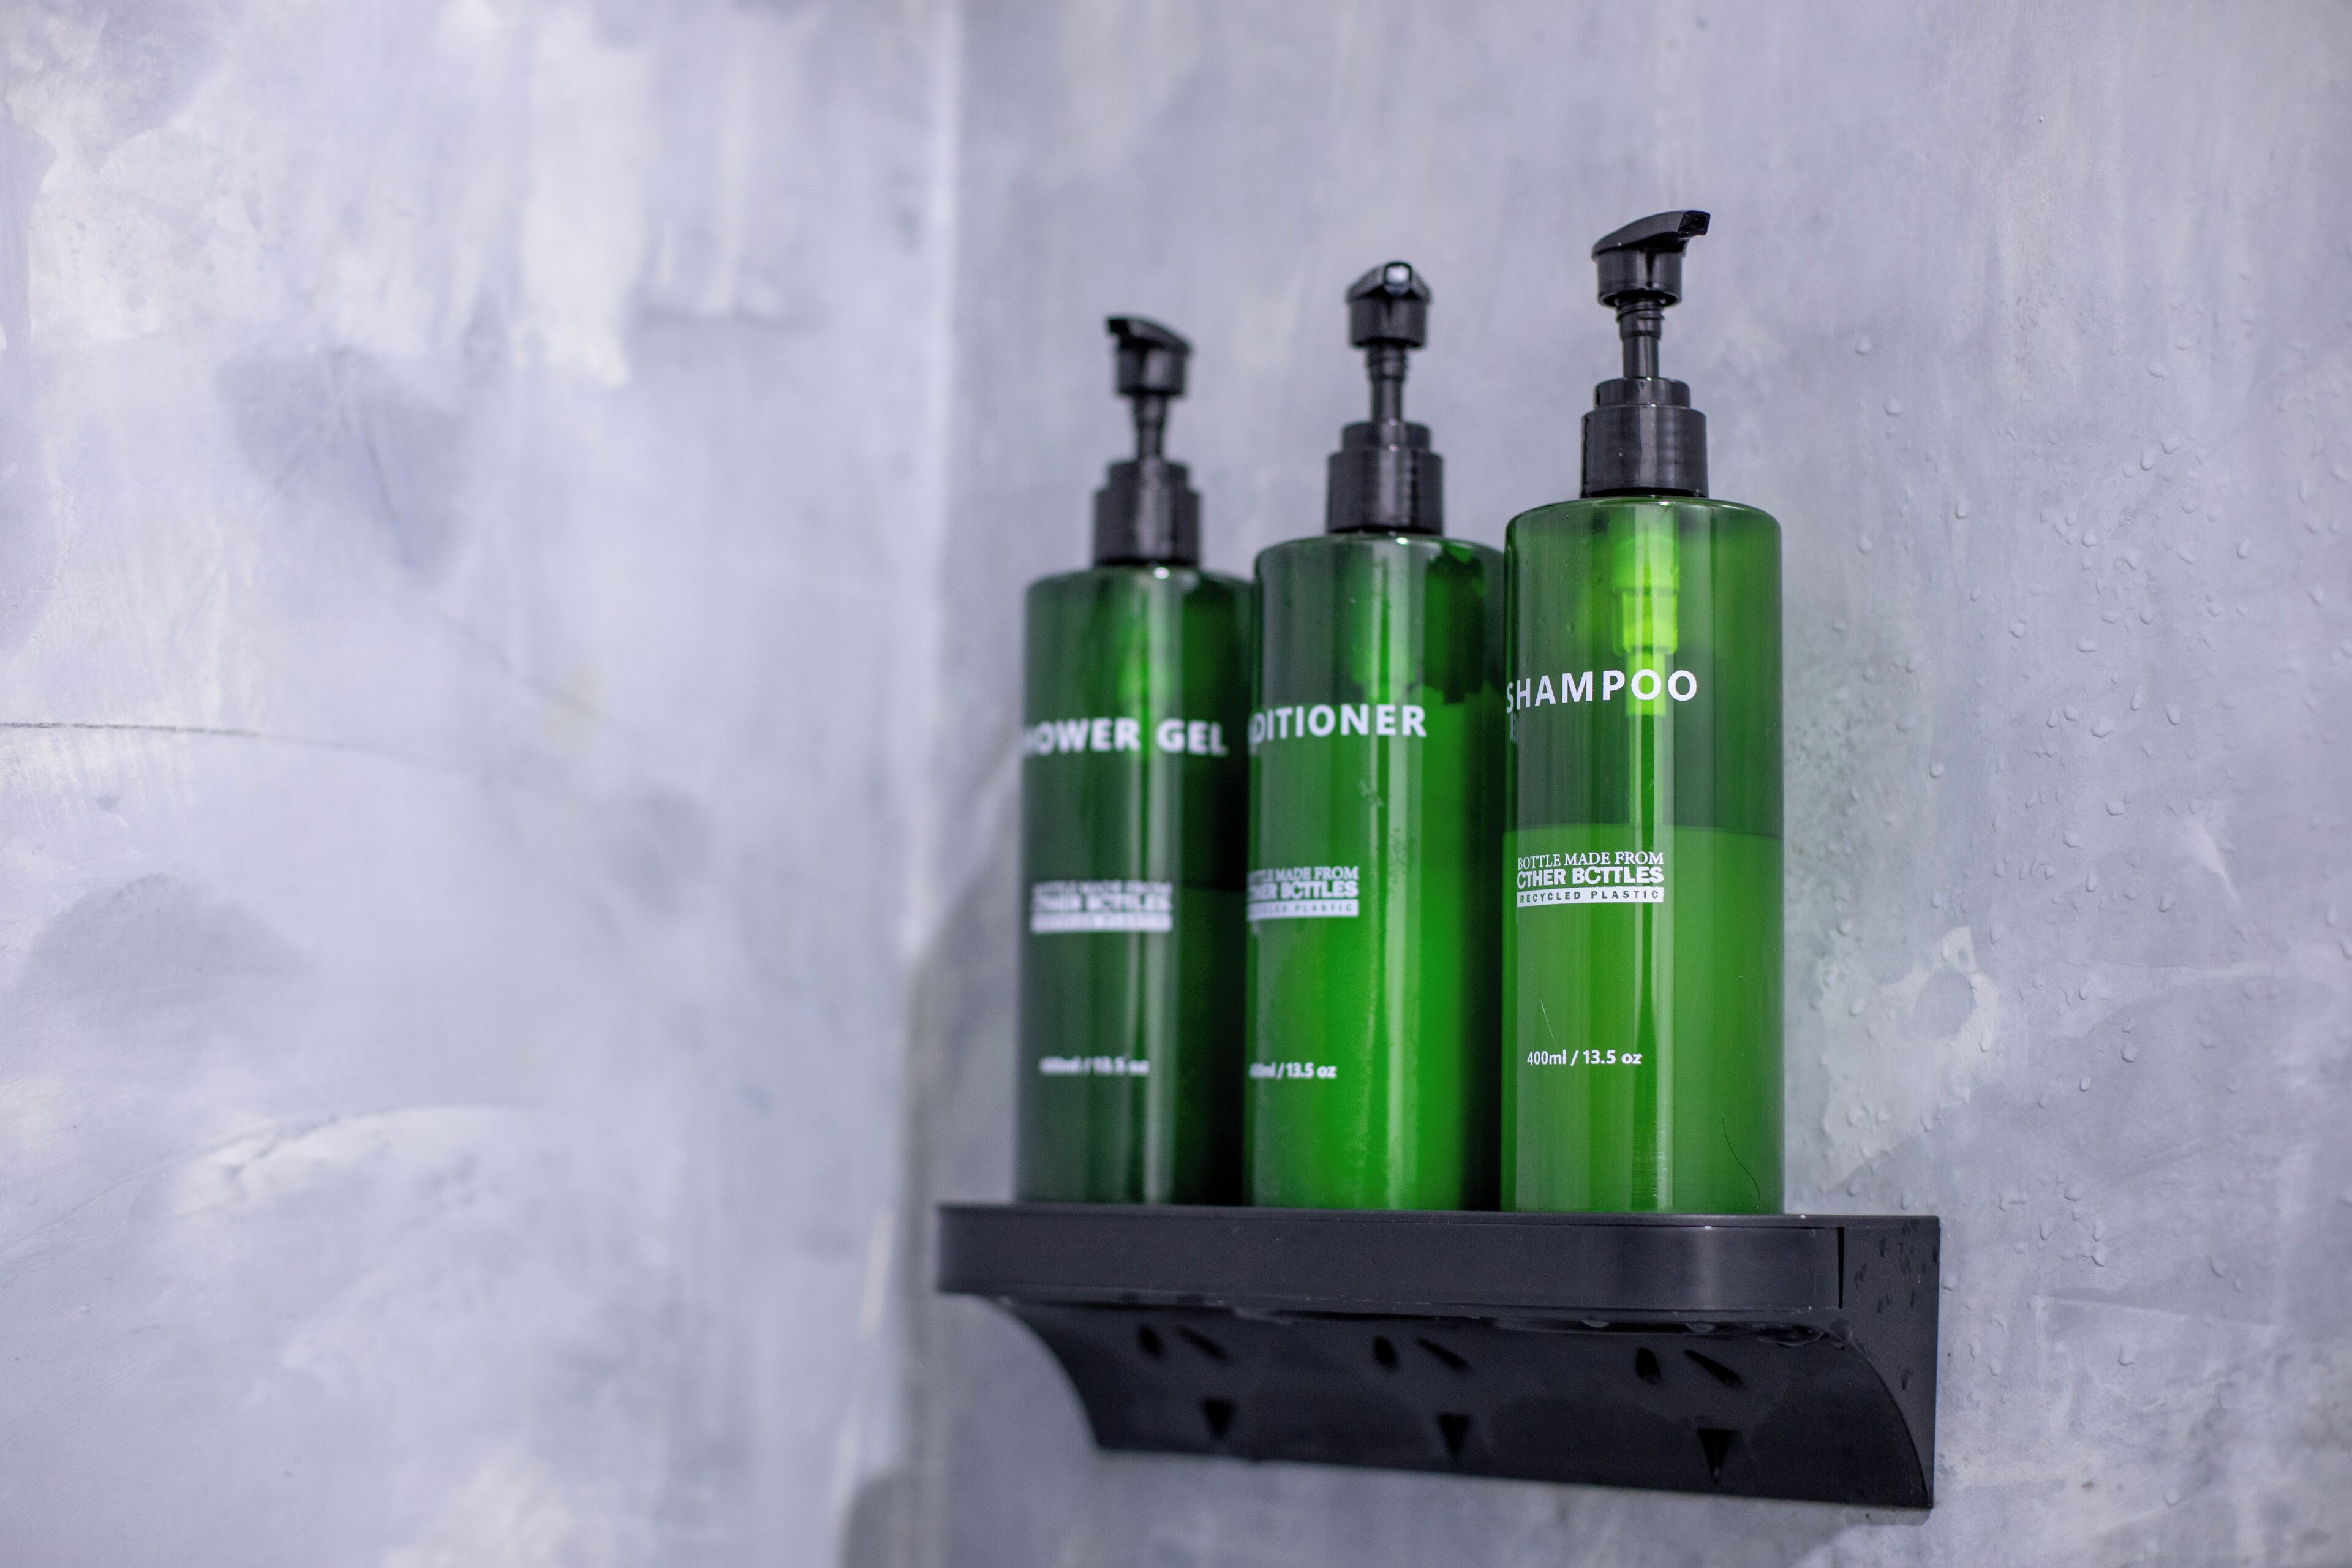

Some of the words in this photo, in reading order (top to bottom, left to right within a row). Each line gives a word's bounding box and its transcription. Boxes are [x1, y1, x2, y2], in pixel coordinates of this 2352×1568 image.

[1506, 669, 1697, 714] SHAMPOO
[1156, 718, 1229, 758] GEL
[1518, 854, 1561, 870] BOTTLE
[1564, 852, 1611, 865] MADE
[1615, 851, 1664, 865] FROM
[1314, 866, 1359, 880] FROM
[1520, 891, 1581, 903] RECYCLED
[1591, 890, 1659, 899] PLASTIC
[1295, 903, 1352, 912] PLASTIC
[1527, 1049, 1566, 1065] 400ml
[1570, 1050, 1579, 1066] /
[1583, 1050, 1616, 1064] 13.5
[1621, 1054, 1643, 1064] oz
[1286, 1062, 1314, 1078] 13.5
[1317, 1066, 1337, 1079] oz
